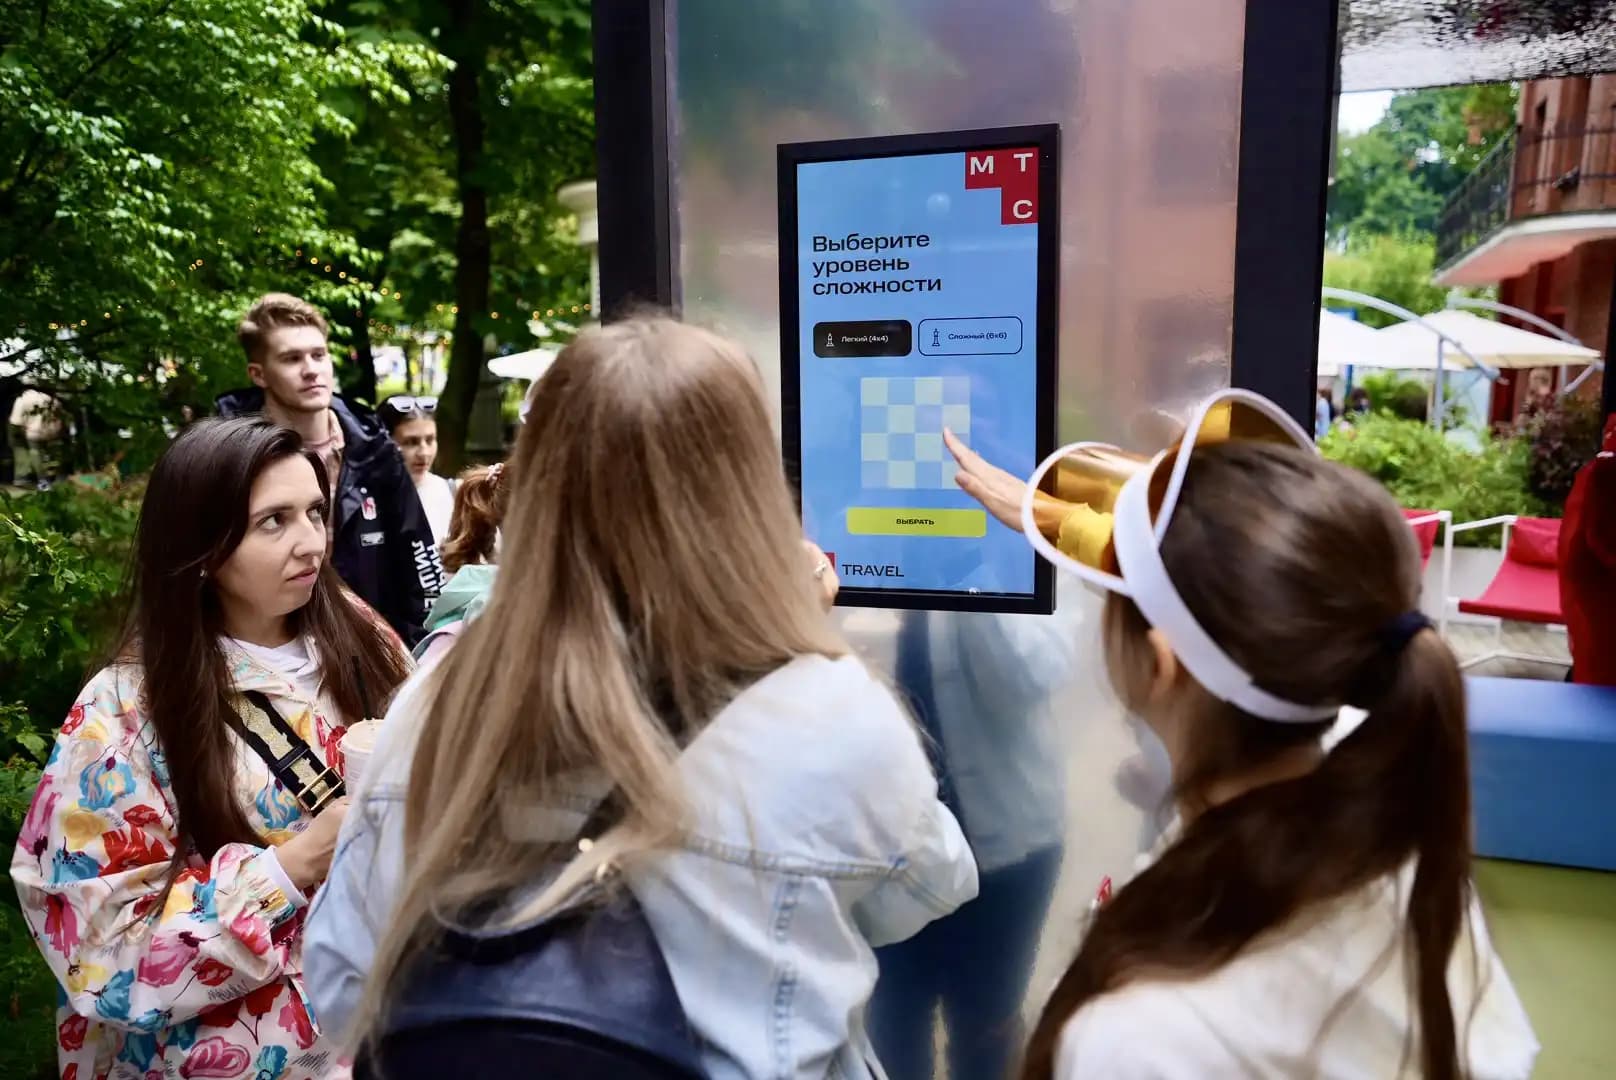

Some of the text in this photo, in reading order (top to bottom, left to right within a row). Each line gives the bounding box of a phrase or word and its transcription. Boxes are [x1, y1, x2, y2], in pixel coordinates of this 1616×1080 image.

[812, 232, 930, 253] Выберите
[812, 258, 910, 278] уровень
[812, 278, 942, 296] сложности
[841, 335, 868, 343] Легкий
[948, 332, 984, 340] Сложный
[842, 564, 905, 578] TRAVEL
